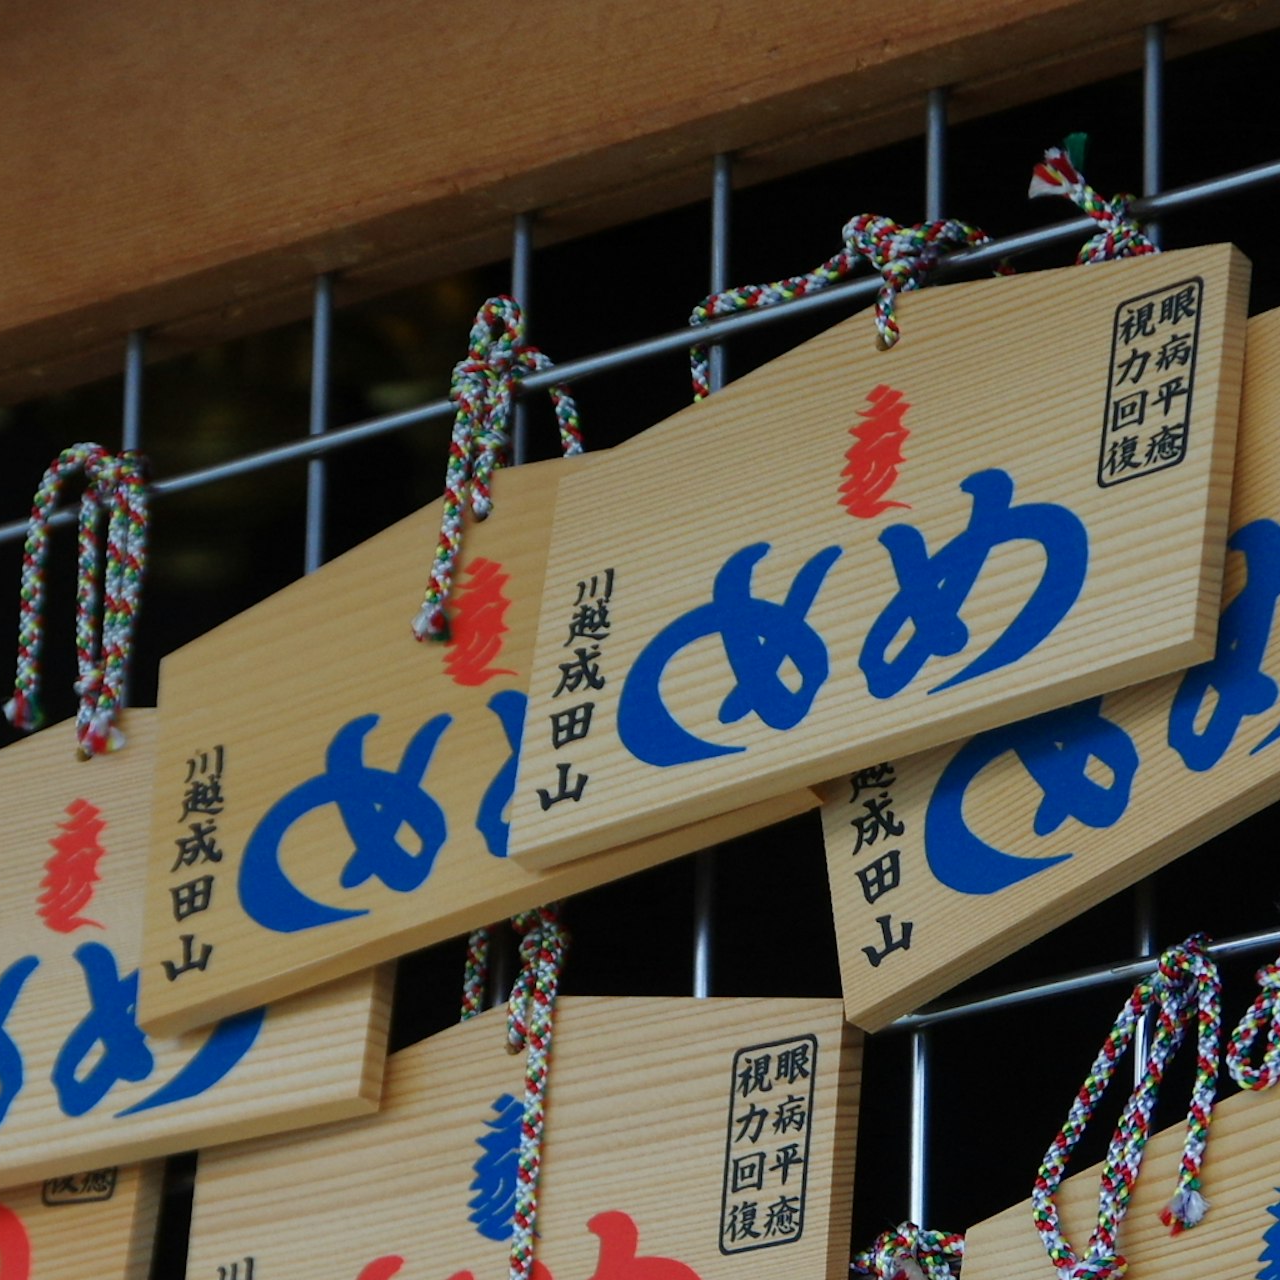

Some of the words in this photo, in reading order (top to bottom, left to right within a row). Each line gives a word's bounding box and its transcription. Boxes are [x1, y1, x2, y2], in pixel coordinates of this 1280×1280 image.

[1103, 308, 1156, 475] 視力回復
[1144, 284, 1197, 466] 眼病平癒
[537, 569, 614, 811] 川越成田山
[617, 467, 1088, 768] めめ
[163, 746, 224, 981] 川越成田山
[723, 1057, 773, 1243] 視力回復
[764, 1044, 811, 1237] 眼病平癒
